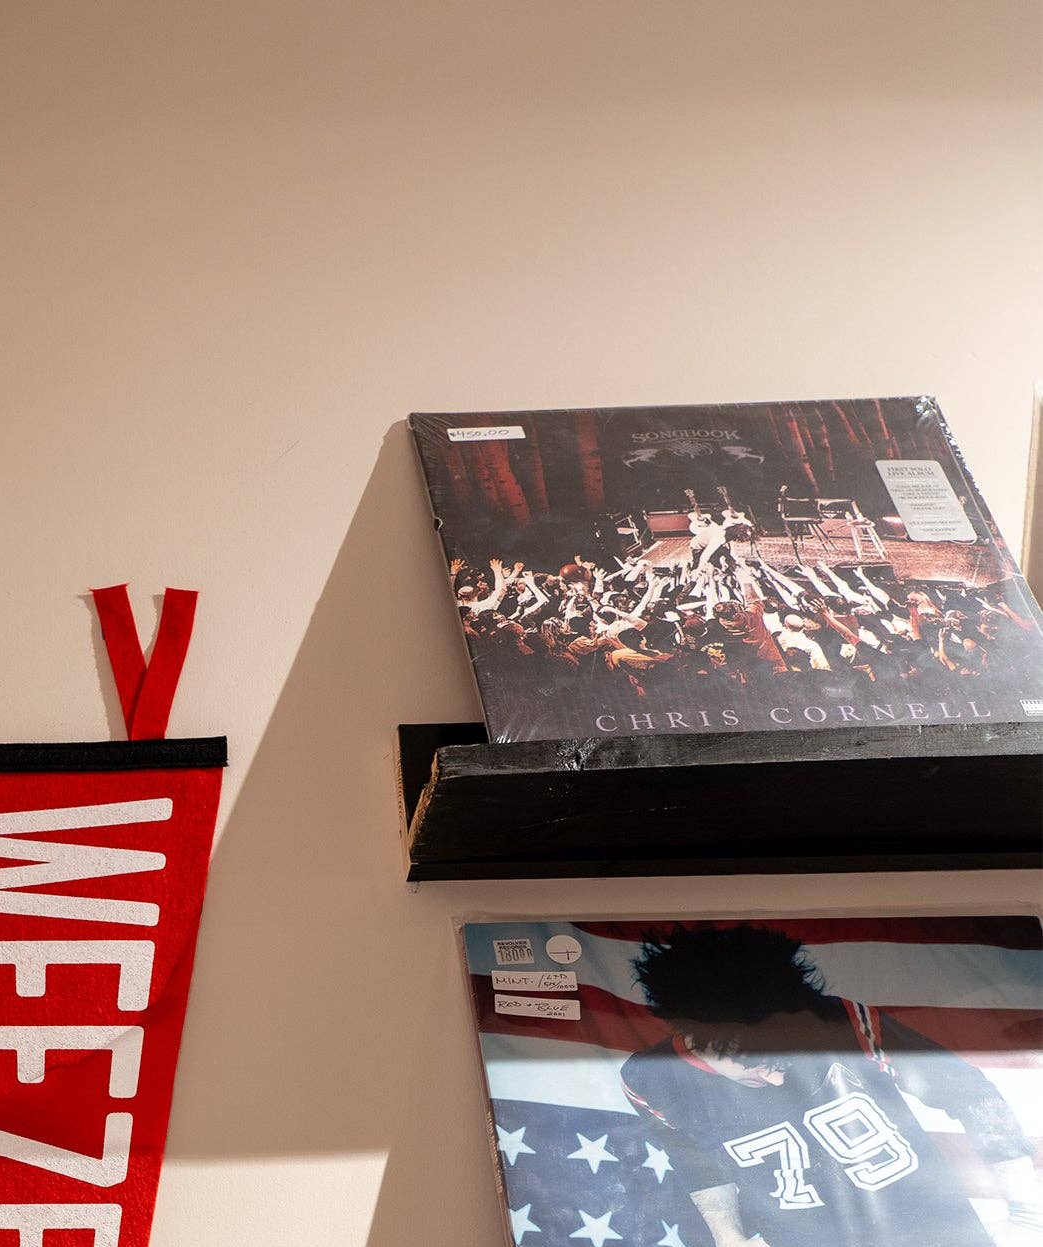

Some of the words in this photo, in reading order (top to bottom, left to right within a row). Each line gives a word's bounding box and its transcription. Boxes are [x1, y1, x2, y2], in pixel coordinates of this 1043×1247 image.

[631, 429, 741, 443] SONGBOOK
[595, 708, 740, 733] CHRIS
[770, 700, 991, 724] CORNELL
[722, 1092, 919, 1210] 79
